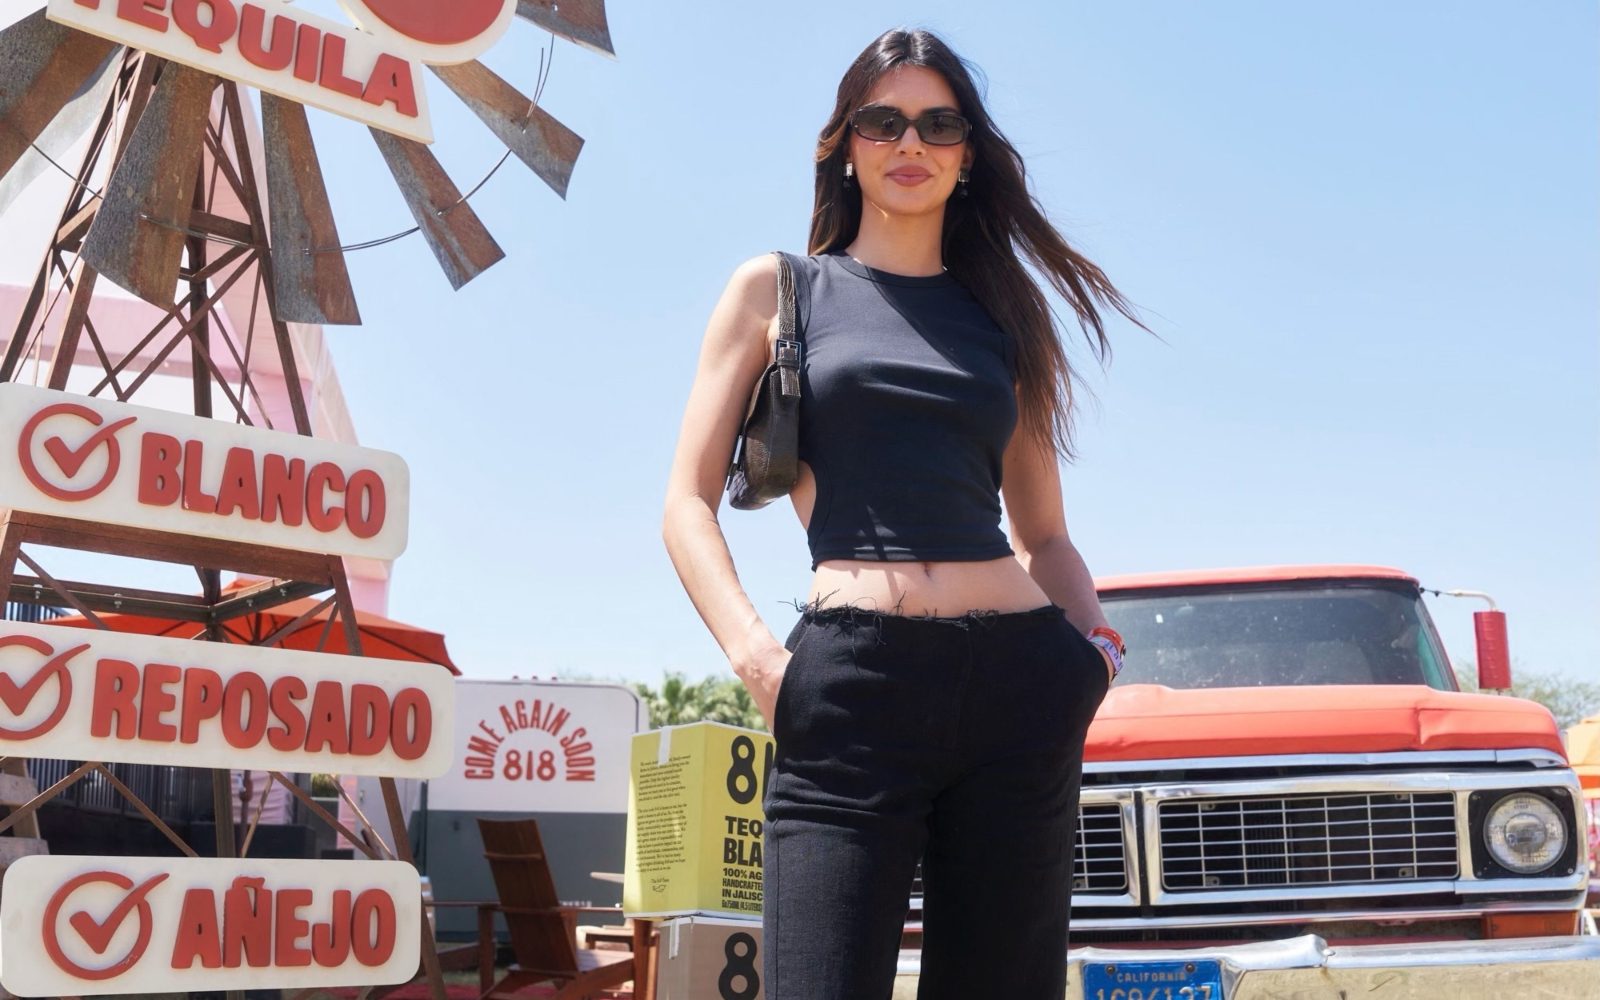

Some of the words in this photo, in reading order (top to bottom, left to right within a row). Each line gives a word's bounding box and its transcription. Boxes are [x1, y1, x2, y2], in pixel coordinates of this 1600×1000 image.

[73, 0, 419, 118] EQUILA
[138, 431, 387, 539] BLANCO
[91, 658, 433, 760] REPOSADO
[464, 720, 505, 780] COME
[499, 699, 571, 737] AGAIN
[560, 727, 596, 782] SOON
[503, 749, 556, 781] 818
[724, 815, 763, 839] TEQ
[723, 837, 763, 868] BLA
[723, 868, 747, 880] 100%
[722, 888, 732, 898] IN
[171, 876, 397, 969] AÑEJO
[1116, 971, 1187, 984] CALIFORNIA
